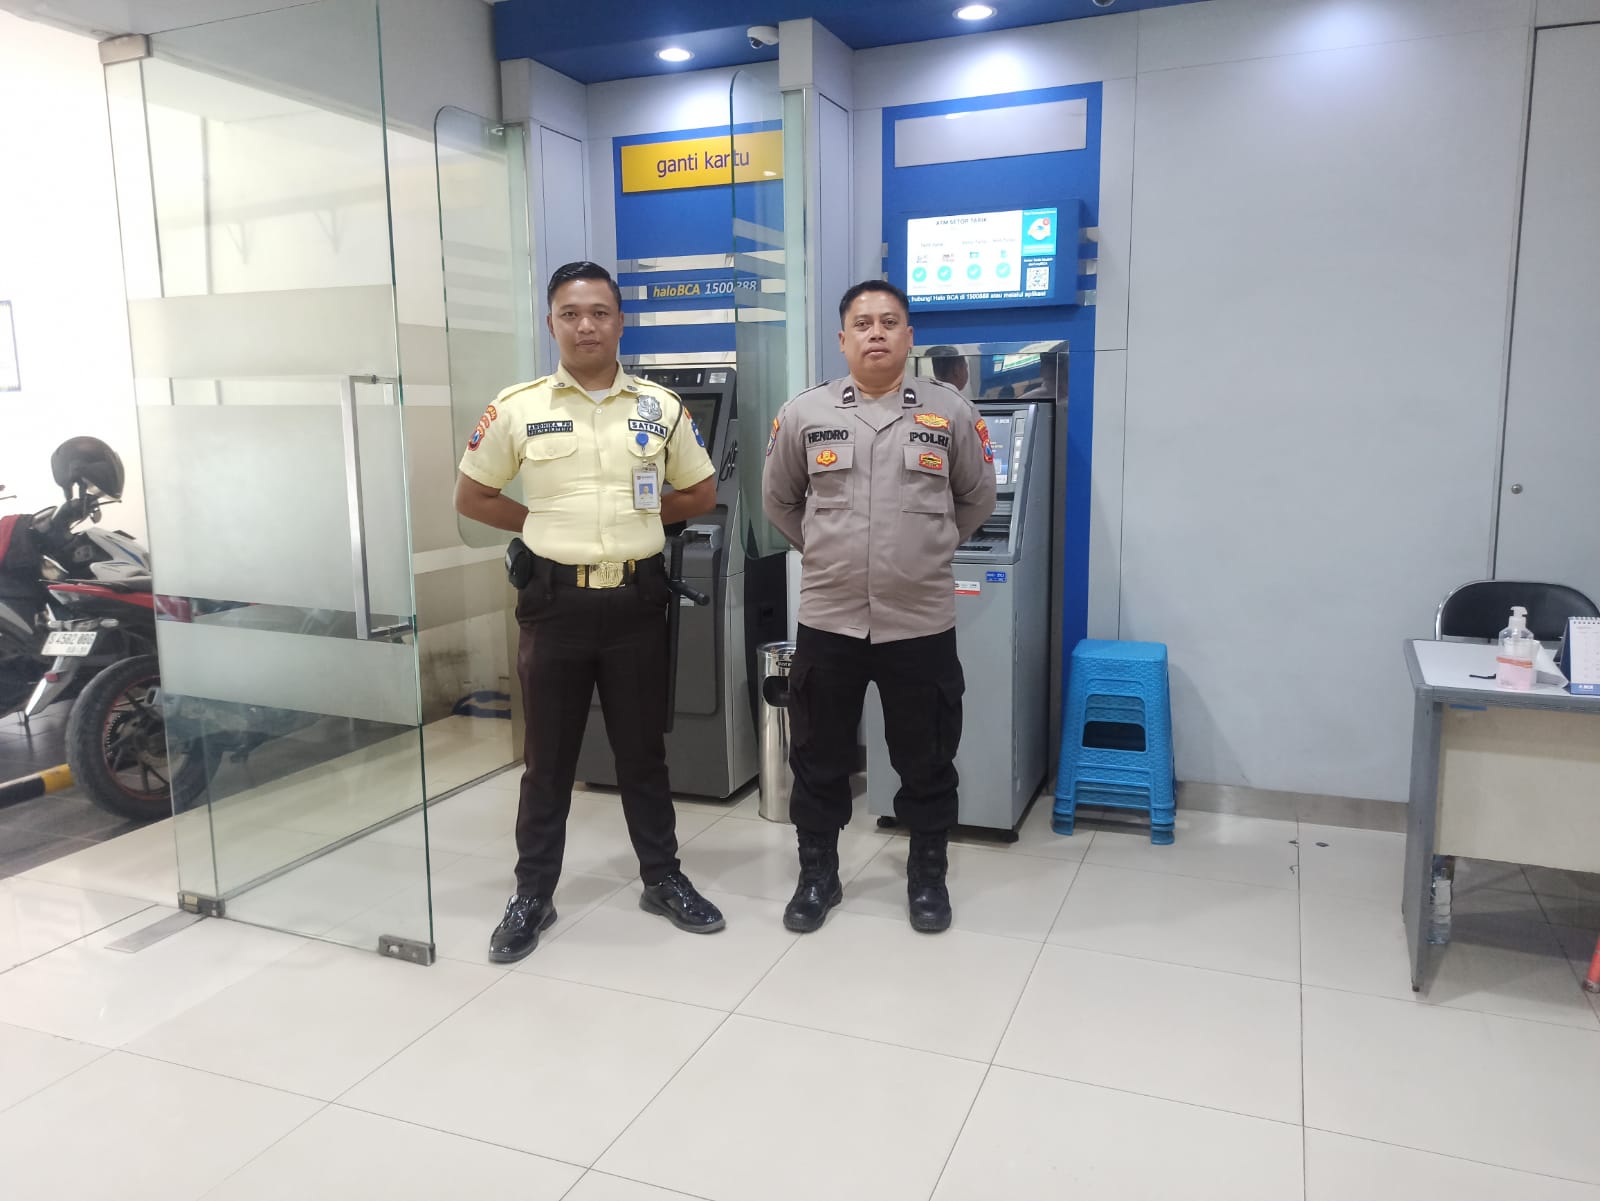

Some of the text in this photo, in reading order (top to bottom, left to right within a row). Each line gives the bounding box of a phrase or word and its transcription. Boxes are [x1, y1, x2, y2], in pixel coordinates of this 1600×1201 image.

[656, 149, 750, 178] ganti kartu
[653, 283, 701, 298] haloBCA
[631, 421, 666, 436] SATPAM
[807, 429, 849, 444] HENDRO
[909, 431, 950, 448] POLRI
